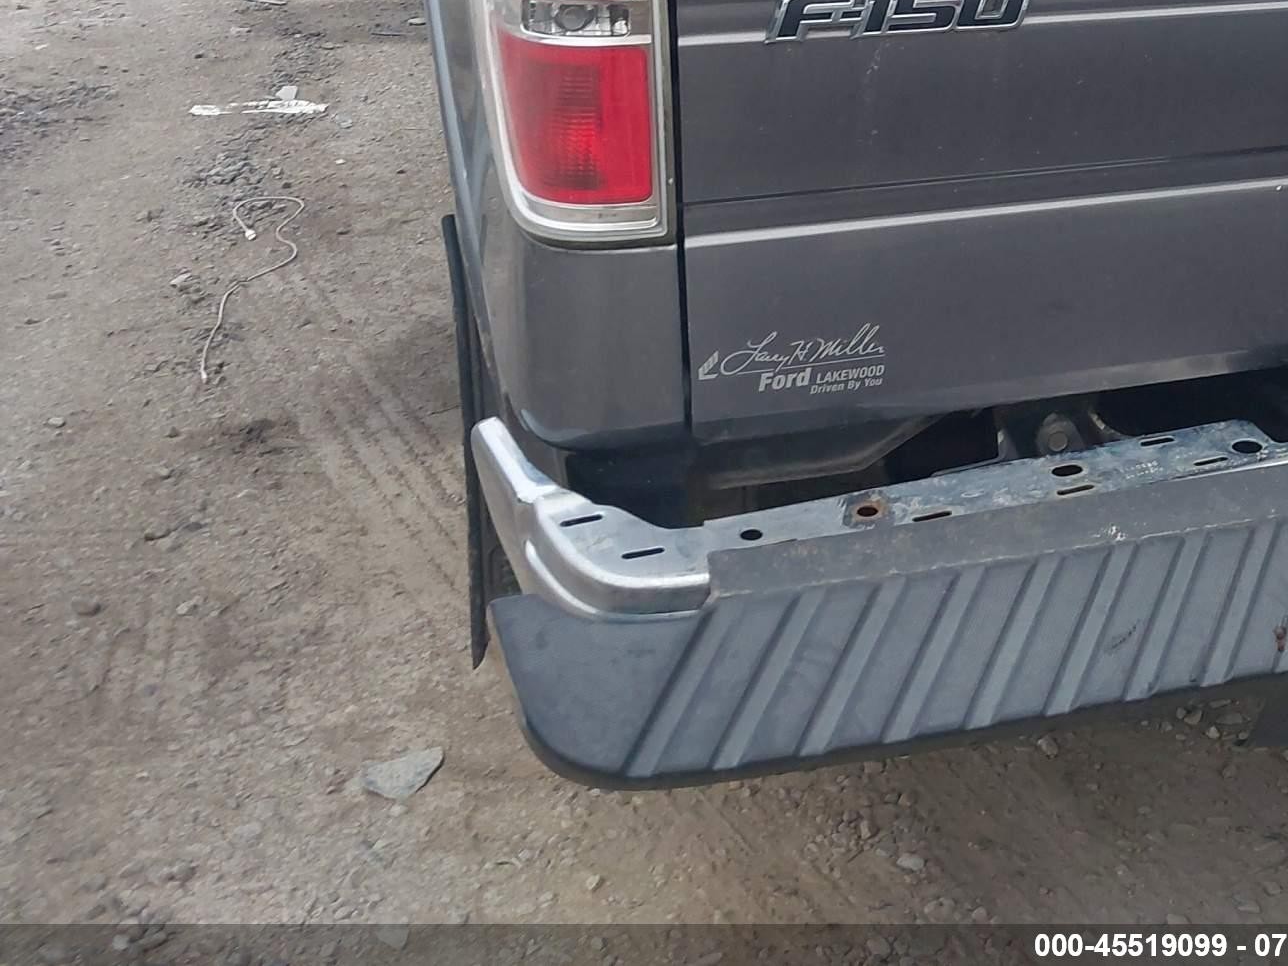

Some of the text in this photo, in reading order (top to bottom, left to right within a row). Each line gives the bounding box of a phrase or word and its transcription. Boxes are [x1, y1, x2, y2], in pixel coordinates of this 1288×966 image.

[720, 331, 791, 375] Larry
[808, 321, 885, 363] Miller
[758, 364, 885, 392] Ford LAKEWOOD
[809, 377, 883, 395] Driven By You
